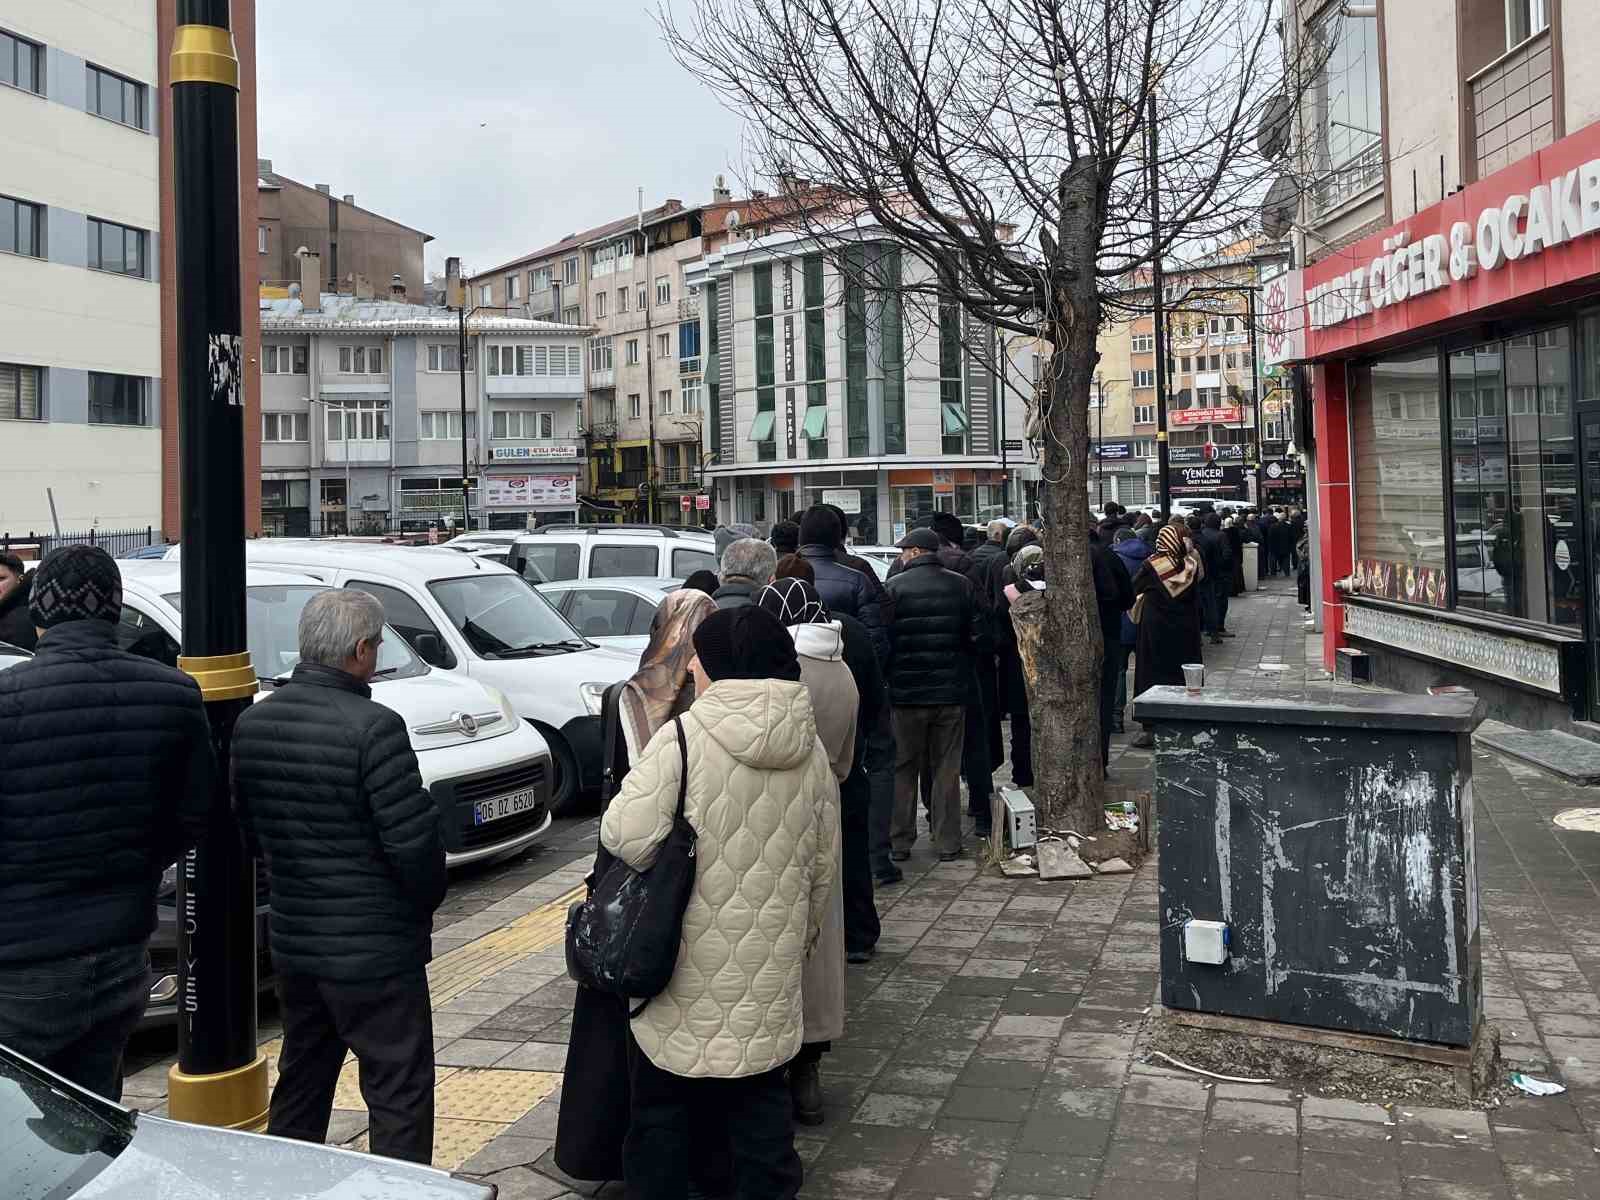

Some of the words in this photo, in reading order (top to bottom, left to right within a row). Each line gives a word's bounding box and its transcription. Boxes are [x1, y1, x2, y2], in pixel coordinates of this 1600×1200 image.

[1371, 232, 1450, 309] CİĞER
[1450, 221, 1477, 281] &
[482, 803, 494, 819] 06
[513, 793, 533, 810] 6520
